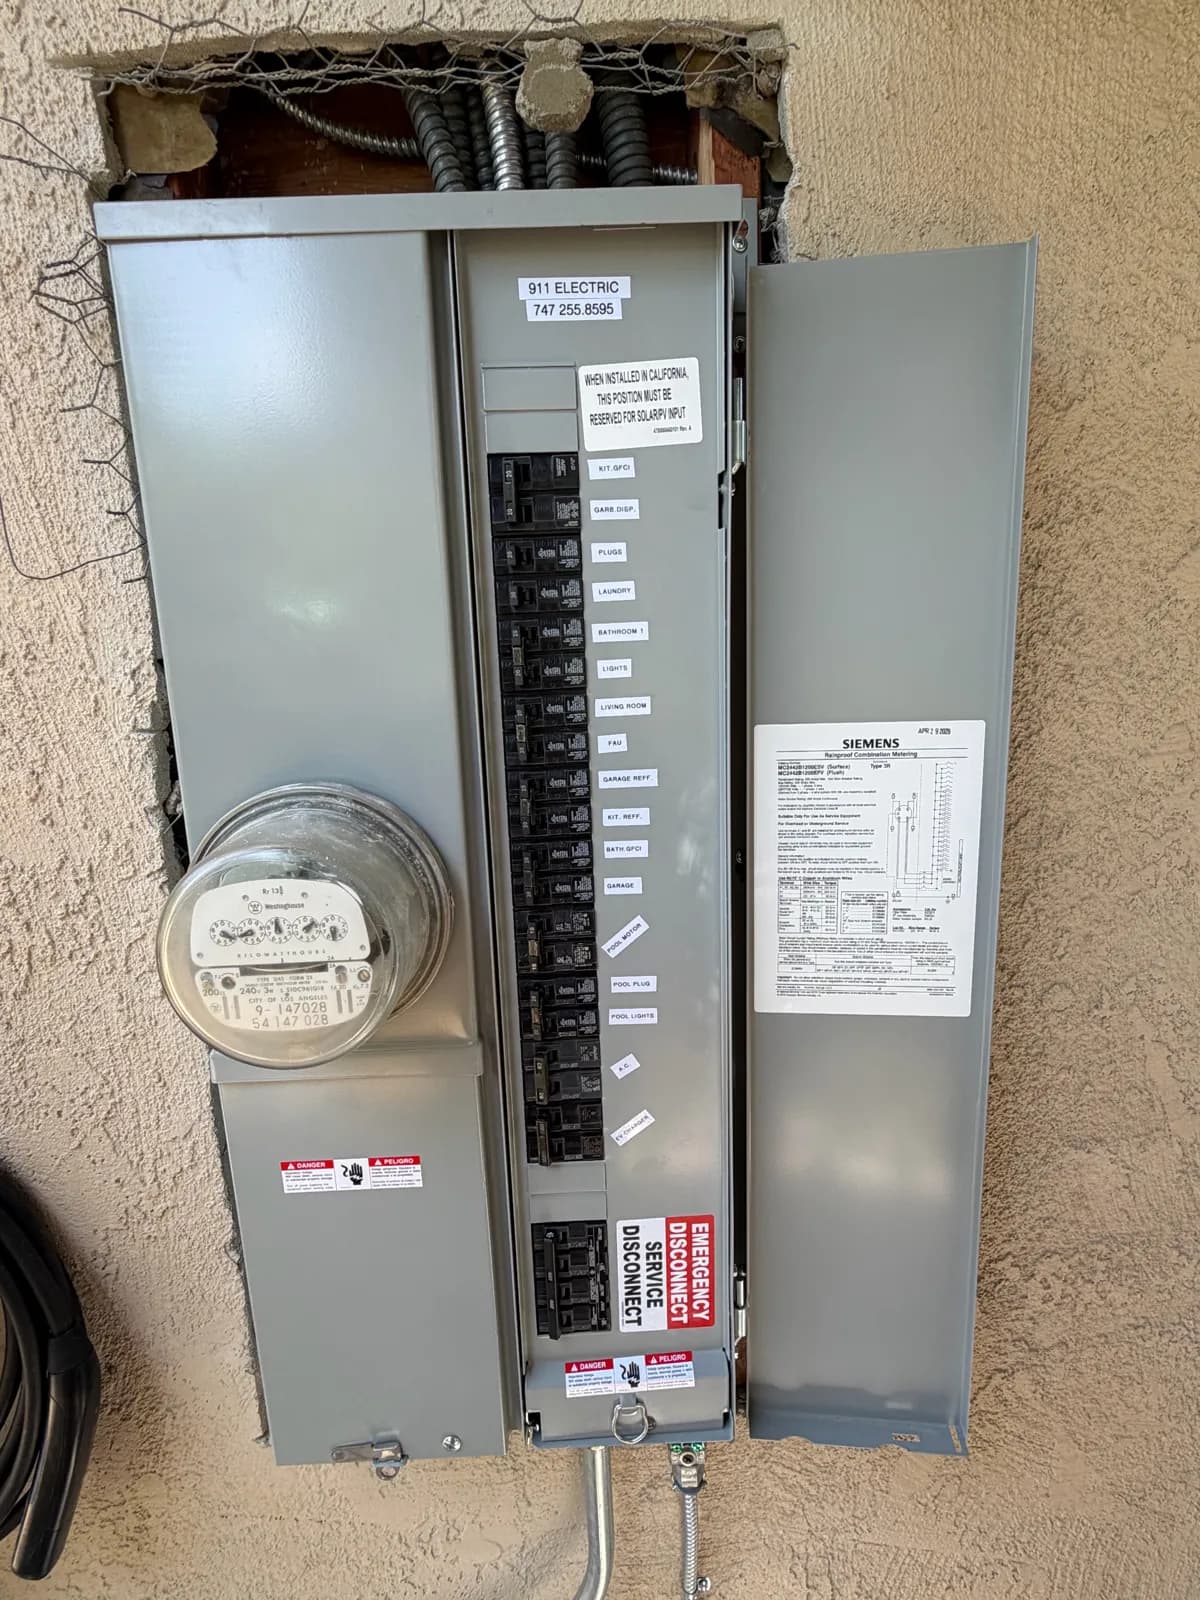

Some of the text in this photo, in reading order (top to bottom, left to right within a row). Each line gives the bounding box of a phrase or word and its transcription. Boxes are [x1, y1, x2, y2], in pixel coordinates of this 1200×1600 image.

[528, 281, 620, 294] 911 ELECTRIC
[534, 303, 614, 316] 747 255.8595
[584, 367, 689, 386] WHEN INSTALLED IN CALIFORNIA,
[597, 388, 672, 406] THIS POSITION MUST BE
[590, 406, 686, 426] RESERVED FOR SOLAR/PV INPUT
[842, 738, 900, 749] SIEMENS
[607, 923, 642, 953] POOL MOTOR
[623, 1225, 642, 1326] DISCONNECT
[646, 1241, 663, 1308] SERVICE
[670, 1222, 688, 1324] DISCONNECT
[692, 1223, 710, 1320] EMERGENCY
[580, 1361, 606, 1370] DANGER
[659, 1354, 687, 1362] PELIGRO
